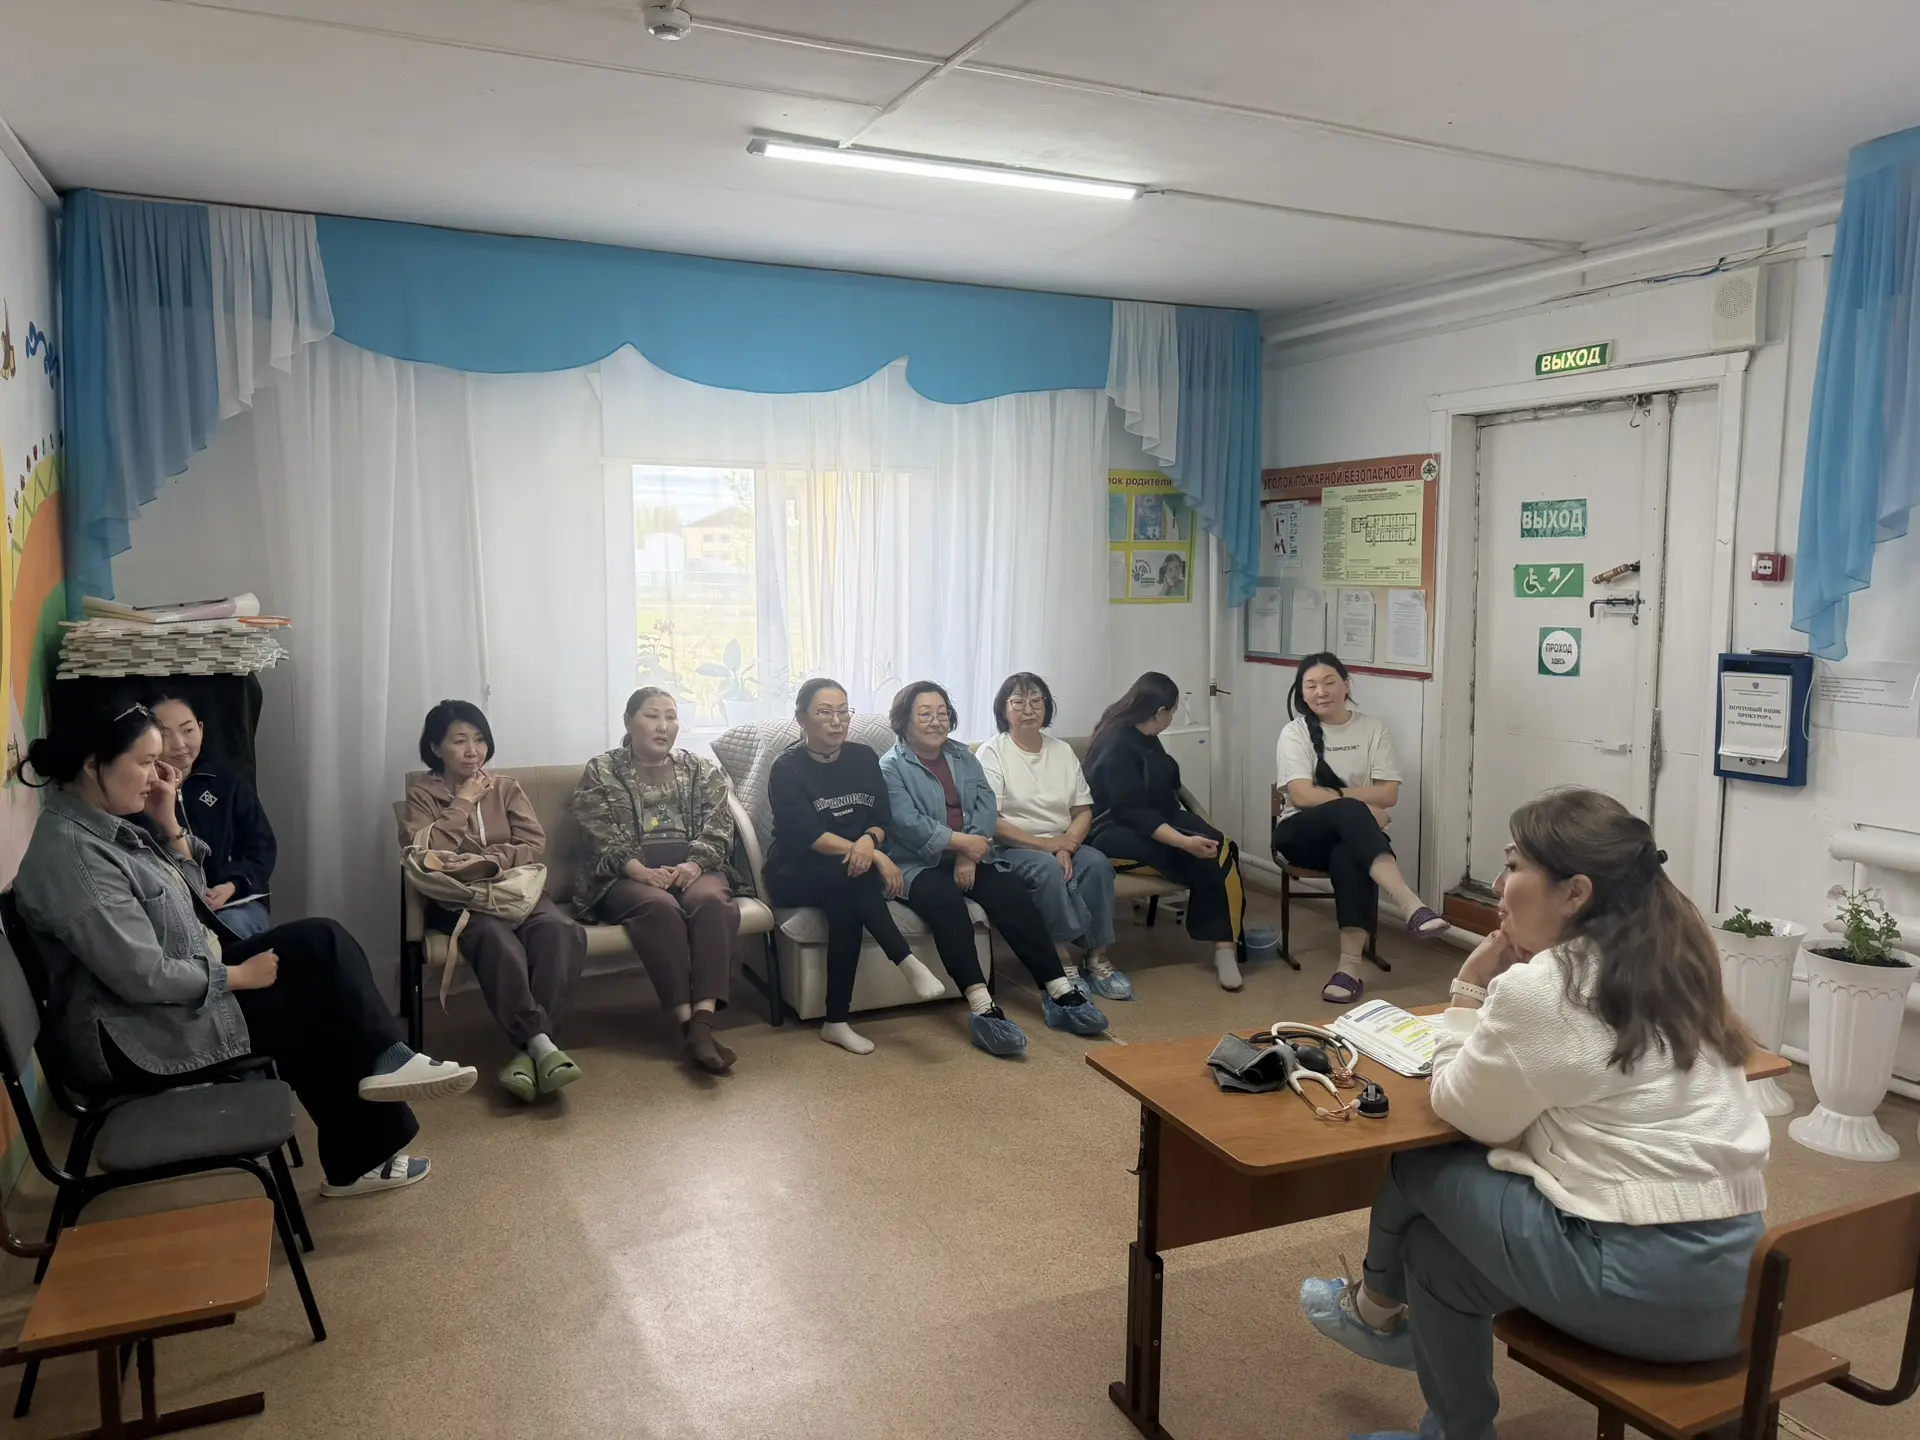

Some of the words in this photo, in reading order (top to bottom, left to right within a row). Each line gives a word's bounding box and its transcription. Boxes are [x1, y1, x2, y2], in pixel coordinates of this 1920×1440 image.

[1541, 346, 1600, 372] ВЫХОД
[1125, 477, 1172, 487] родителя
[1263, 476, 1293, 489] УГОЛОК
[1344, 464, 1415, 483] БЕЗОПАСНОСТИ
[1522, 508, 1583, 531] ВЫХОД
[1545, 643, 1573, 655] ПРОХОД
[1729, 704, 1763, 713] ПОЧТОВЫЙ
[1737, 712, 1772, 720] ПРОКУРОРА
